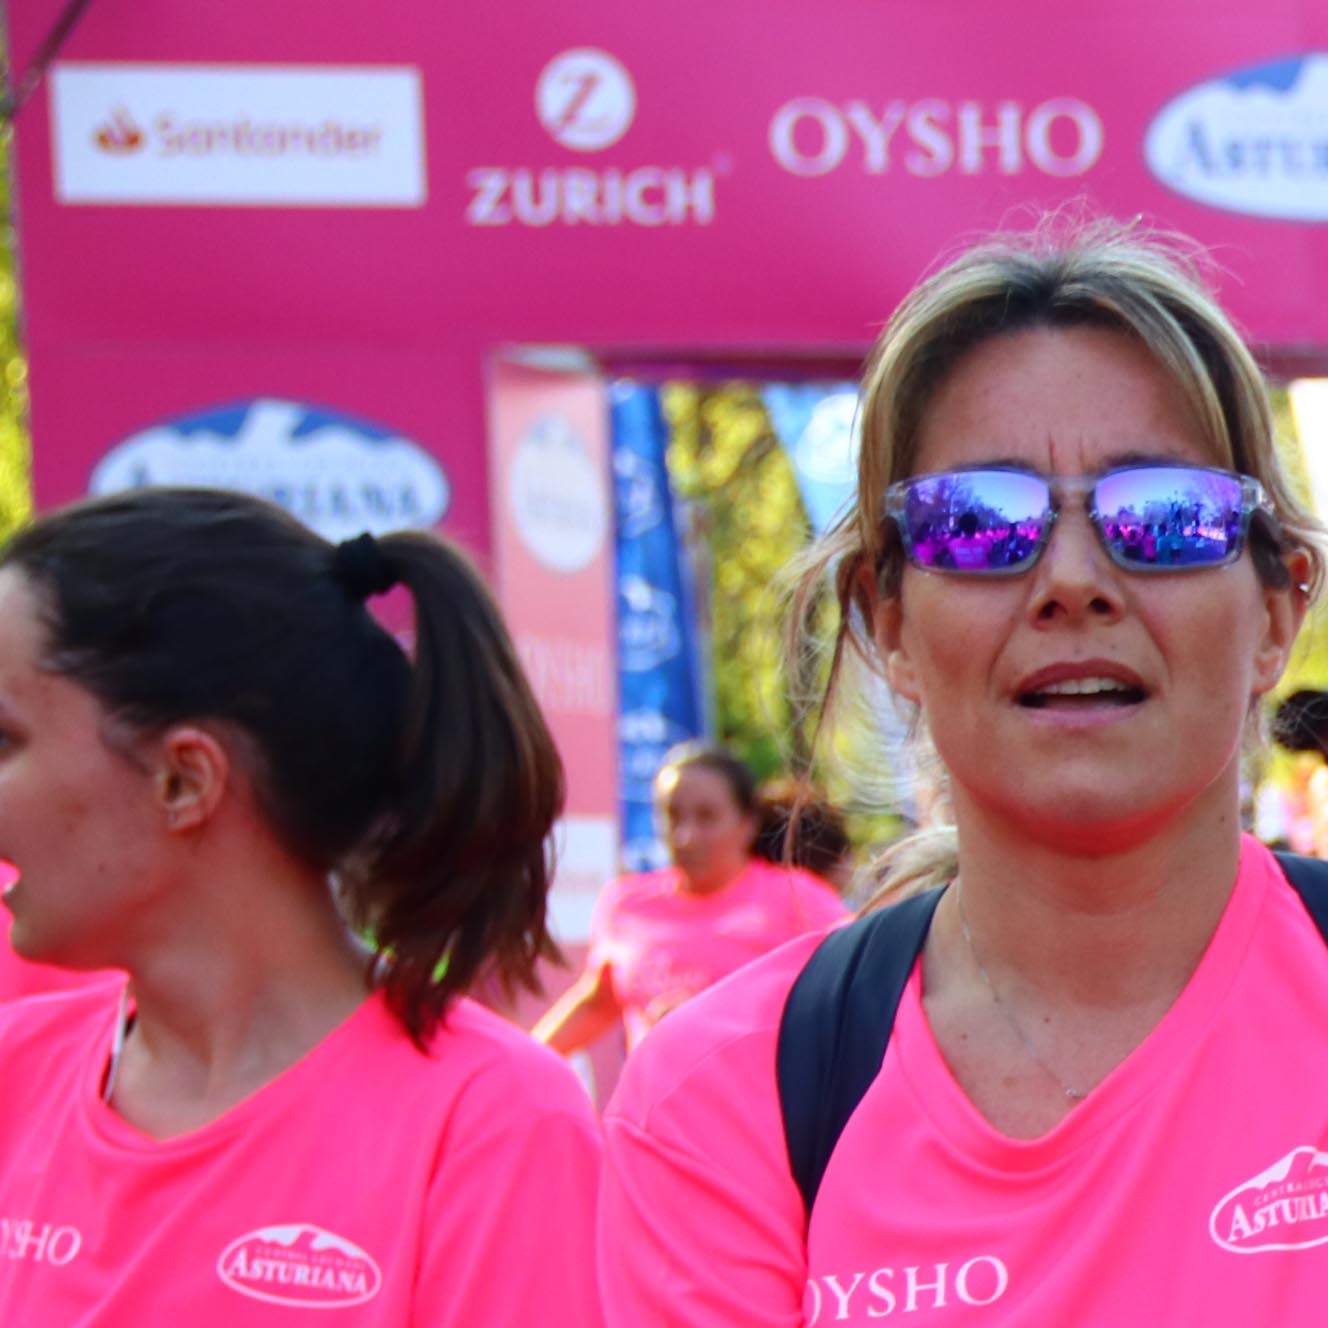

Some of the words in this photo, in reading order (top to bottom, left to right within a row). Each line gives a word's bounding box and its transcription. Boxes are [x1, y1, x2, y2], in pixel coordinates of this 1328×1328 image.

[154, 114, 381, 157] Santander
[768, 97, 1104, 177] OYSHO
[465, 166, 715, 226] ZURICH
[227, 1247, 368, 1297] ASTURIANA
